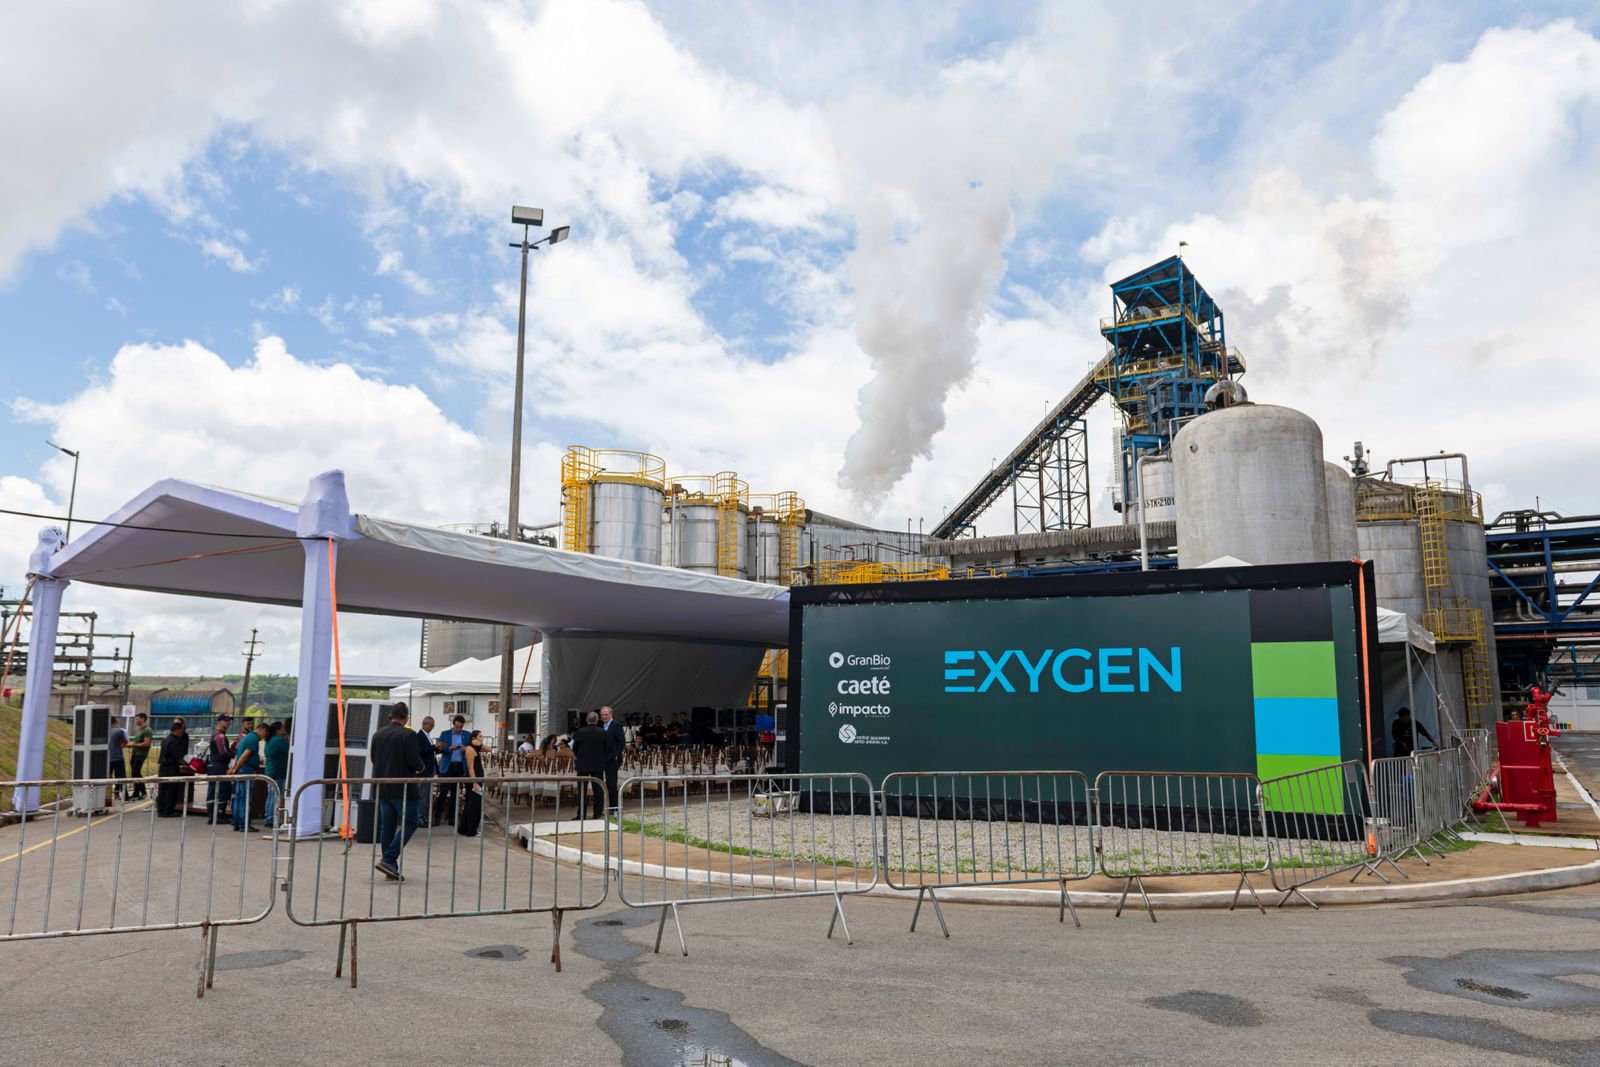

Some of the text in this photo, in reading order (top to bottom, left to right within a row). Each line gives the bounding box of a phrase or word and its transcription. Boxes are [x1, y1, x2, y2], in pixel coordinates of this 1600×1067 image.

[847, 654, 891, 666] GranBio
[944, 647, 1183, 693] EXYGEN
[837, 675, 891, 695] caeté
[839, 702, 891, 717] impacto
